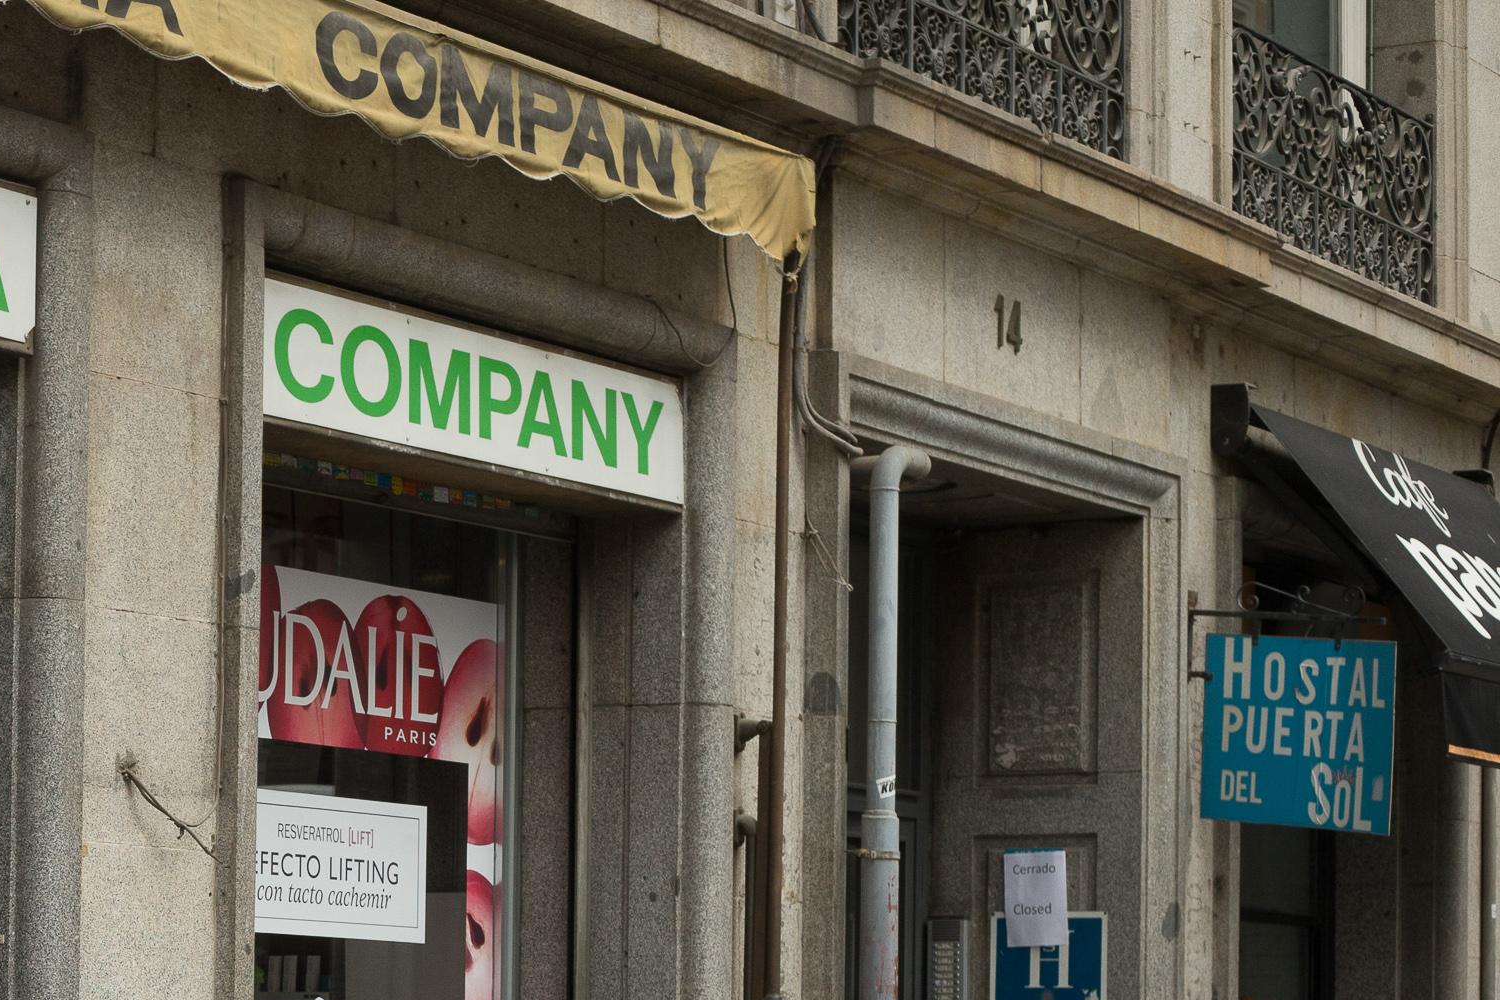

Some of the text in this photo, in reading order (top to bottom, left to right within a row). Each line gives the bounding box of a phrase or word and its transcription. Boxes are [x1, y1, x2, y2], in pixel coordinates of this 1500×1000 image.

[315, 10, 721, 210] COMPANY
[993, 294, 1023, 356] 14
[274, 308, 663, 476] COMPANY
[1223, 637, 1386, 709] HOSTAL
[384, 726, 438, 747] PARIS
[1221, 704, 1364, 762] PUERTA
[1220, 769, 1262, 804] DEL
[277, 823, 374, 848] RESVERATROL [LIFT]
[329, 857, 399, 885] LIFTING
[1012, 862, 1056, 875] Cerrado
[257, 884, 392, 909] con tacto cachemir
[1013, 903, 1053, 916] Closed
